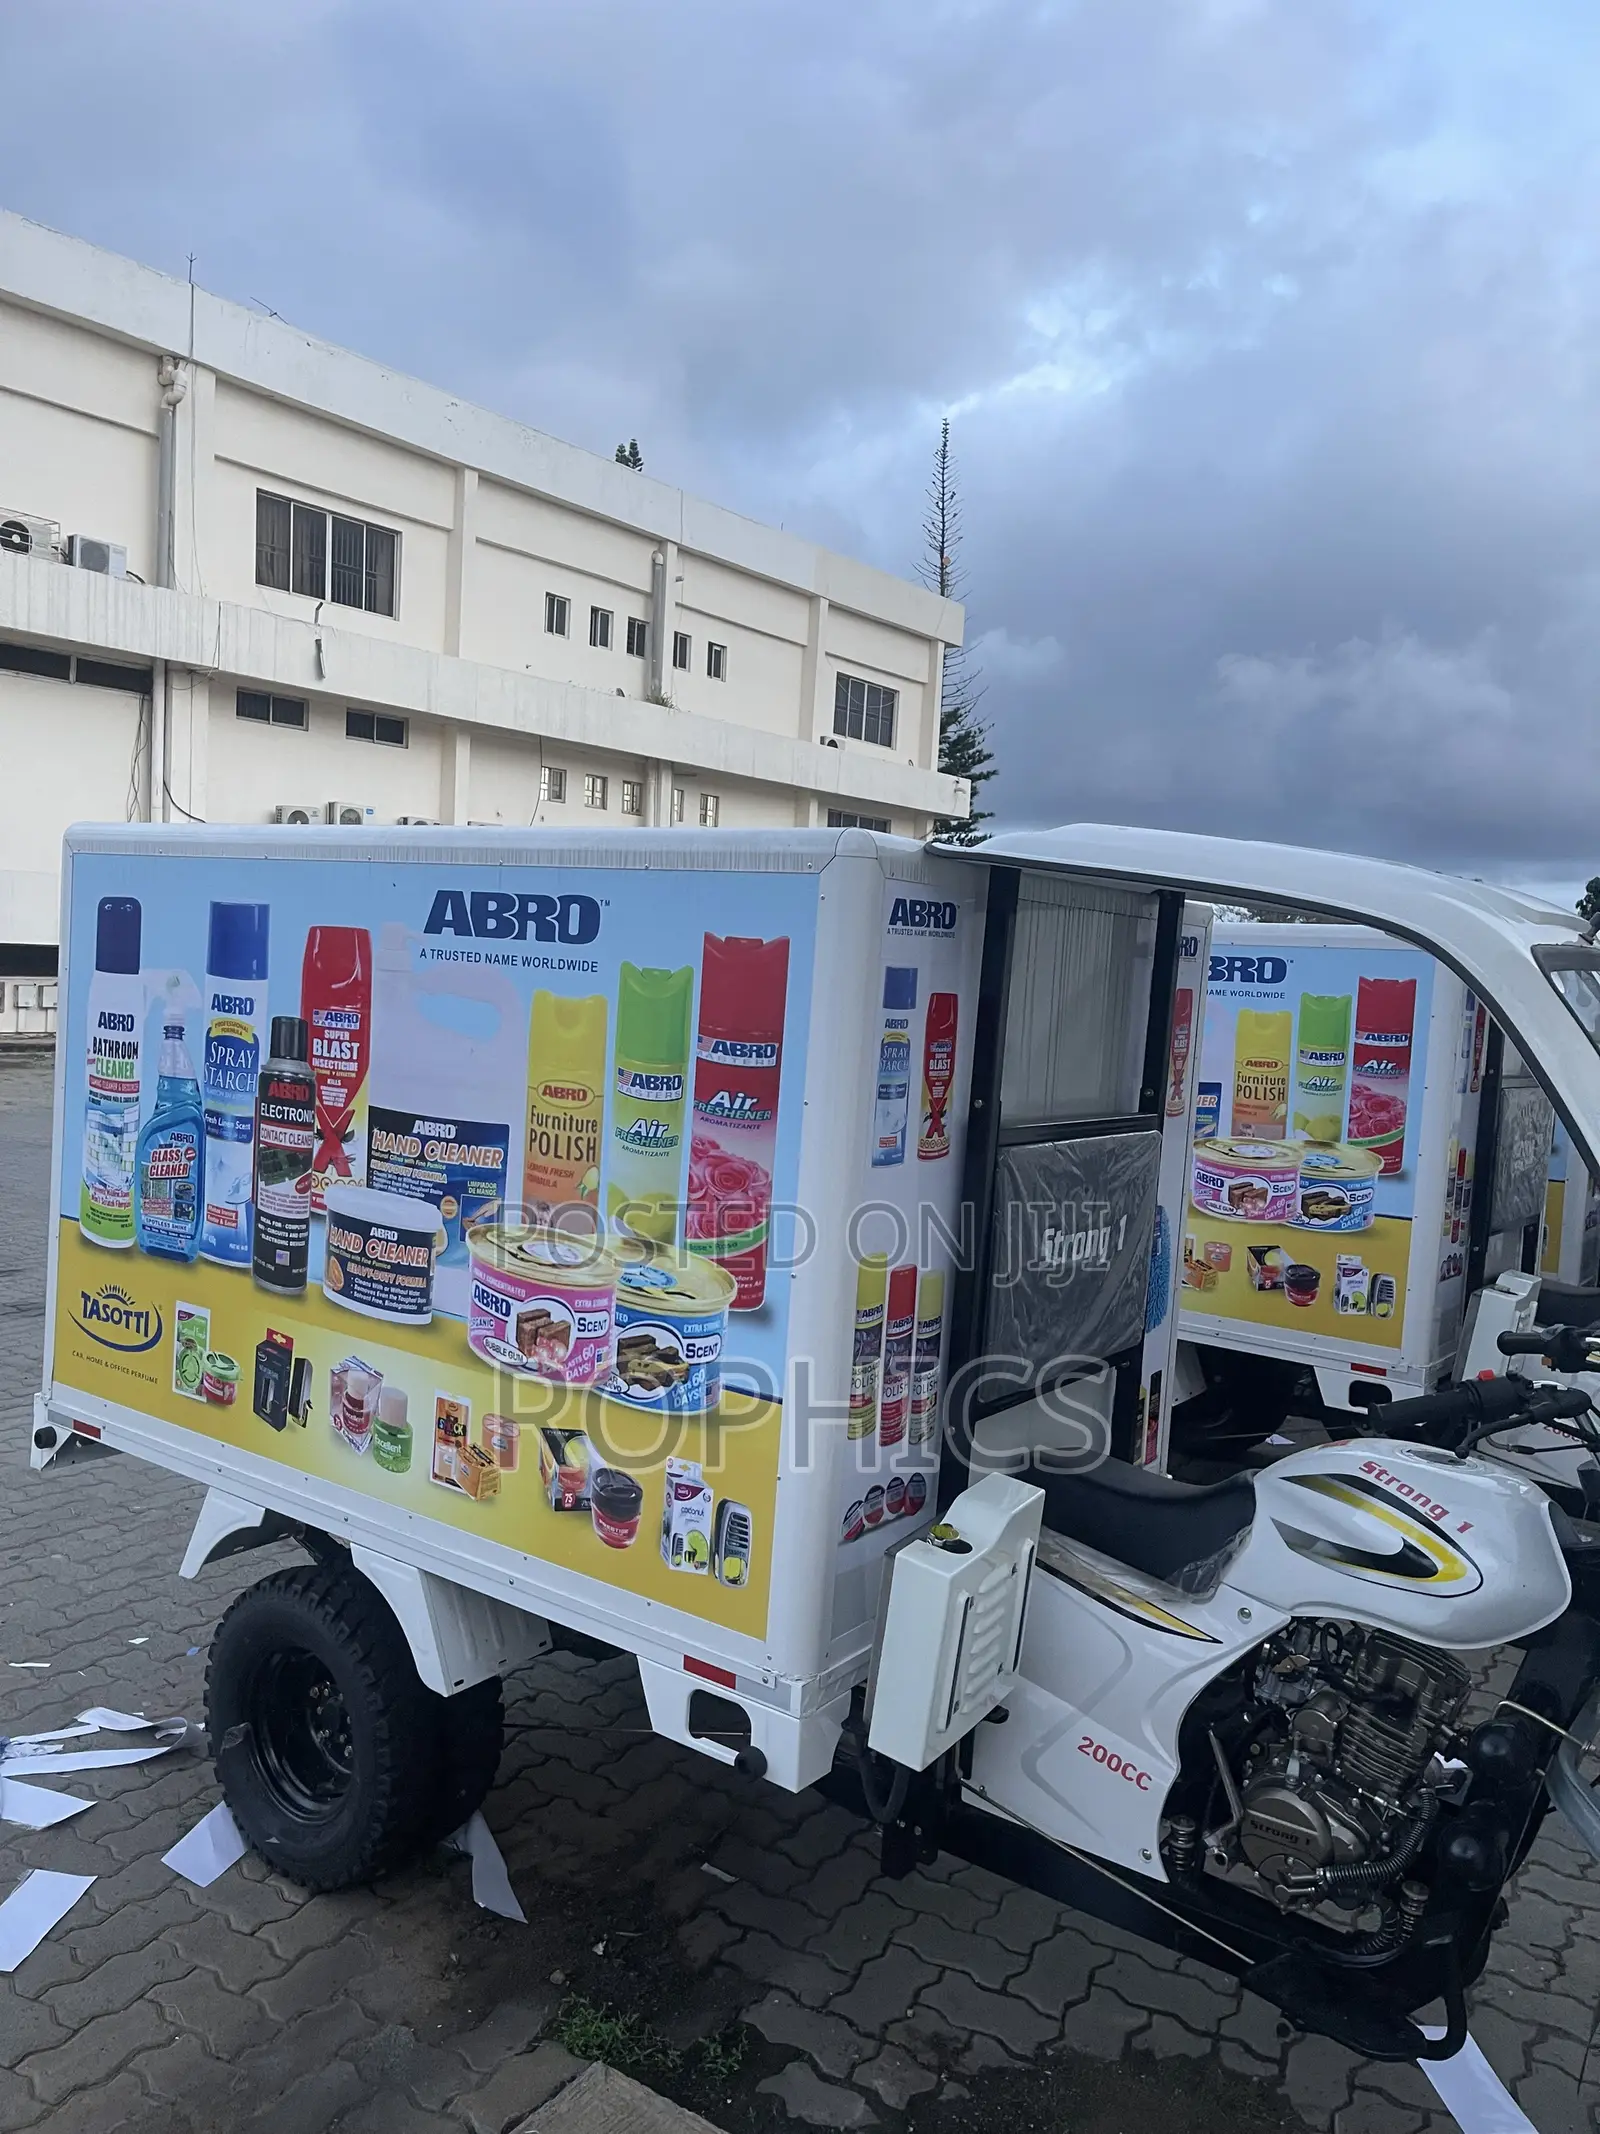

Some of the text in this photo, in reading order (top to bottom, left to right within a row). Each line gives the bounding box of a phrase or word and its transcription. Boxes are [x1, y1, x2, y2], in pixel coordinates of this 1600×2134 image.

[423, 889, 601, 944] ABRO
[888, 897, 957, 930] ABRO
[419, 948, 599, 973] A TRUSTED NAME WORLDWIDE
[1208, 956, 1288, 984] BRO
[1229, 990, 1286, 999] WORLDWIDE
[211, 993, 255, 1016] ABRO
[98, 1011, 135, 1032] ABRO
[324, 1010, 360, 1024] ABRO
[885, 1018, 909, 1029] ABRO
[324, 1030, 350, 1041] SUPER
[1364, 1033, 1409, 1042] ABRO
[92, 1036, 139, 1060] BATHROOM
[210, 1041, 255, 1069] SPRAY
[312, 1038, 360, 1060] BLAST
[710, 1040, 777, 1058] ABRO
[883, 1045, 908, 1059] SPRAY
[1309, 1052, 1345, 1061] ABRO
[95, 1057, 135, 1079] CLEANER
[312, 1057, 359, 1071] INSECTICIDE
[929, 1059, 951, 1070] BLAST
[1245, 1060, 1279, 1068] ABRO
[1364, 1060, 1397, 1070] Air
[204, 1063, 257, 1092] STARCH
[630, 1074, 683, 1091] ABRO
[1237, 1071, 1286, 1085] Furniture
[1308, 1076, 1337, 1086] Air
[268, 1081, 309, 1101] ABRO
[541, 1084, 588, 1102] ABRO
[1236, 1084, 1286, 1101] POLISH
[709, 1090, 758, 1110] Air
[261, 1102, 315, 1123] ELECTRONIC
[693, 1099, 772, 1121] FRESHENER
[235, 1120, 250, 1130] Scent
[530, 1105, 598, 1134] Furniture
[629, 1117, 669, 1138] Air
[700, 1116, 762, 1130] AROMATIZANTE
[261, 1126, 288, 1144] CONTACT
[412, 1119, 457, 1139] ABRO
[170, 1132, 194, 1144] ABRO
[529, 1128, 597, 1163] POLISH
[615, 1127, 679, 1149] FRESHENER
[151, 1149, 181, 1162] GLASS
[371, 1129, 505, 1169] HAND CLEANER
[621, 1144, 670, 1157] AROMATIZANTE
[149, 1163, 188, 1178] CLEANER
[550, 1168, 575, 1179] FRESH
[1196, 1171, 1225, 1188] ABRO
[1276, 1199, 1285, 1207] 60
[1354, 1206, 1363, 1217] 60
[370, 1226, 398, 1241] ABRO
[1042, 1214, 1128, 1266] Strong 1
[329, 1224, 429, 1268] HAND CLEANER
[486, 1275, 526, 1297] CONCENTRATED
[473, 1284, 512, 1318] ABRO
[574, 1299, 591, 1308] EXTRA
[81, 1290, 150, 1338] TASOTTI
[861, 1304, 883, 1319] ABRO
[683, 1323, 702, 1333] EXTRA
[892, 1316, 913, 1329] ABRO
[923, 1316, 941, 1329] ABRO
[485, 1339, 524, 1363] BUBBLE GUM
[582, 1344, 595, 1360] 60
[72, 1350, 84, 1361] CAR,
[86, 1356, 103, 1367] HOME
[110, 1362, 130, 1375] OFFICE
[131, 1370, 158, 1384] PERFUME
[566, 1363, 592, 1382] DAYS!
[692, 1369, 705, 1386] 60
[674, 1388, 702, 1408] DAYS!
[374, 1433, 401, 1454] Excellent
[564, 1493, 573, 1503] 75
[1457, 1521, 1474, 1534] 1
[1077, 1736, 1153, 1791] 200CC
